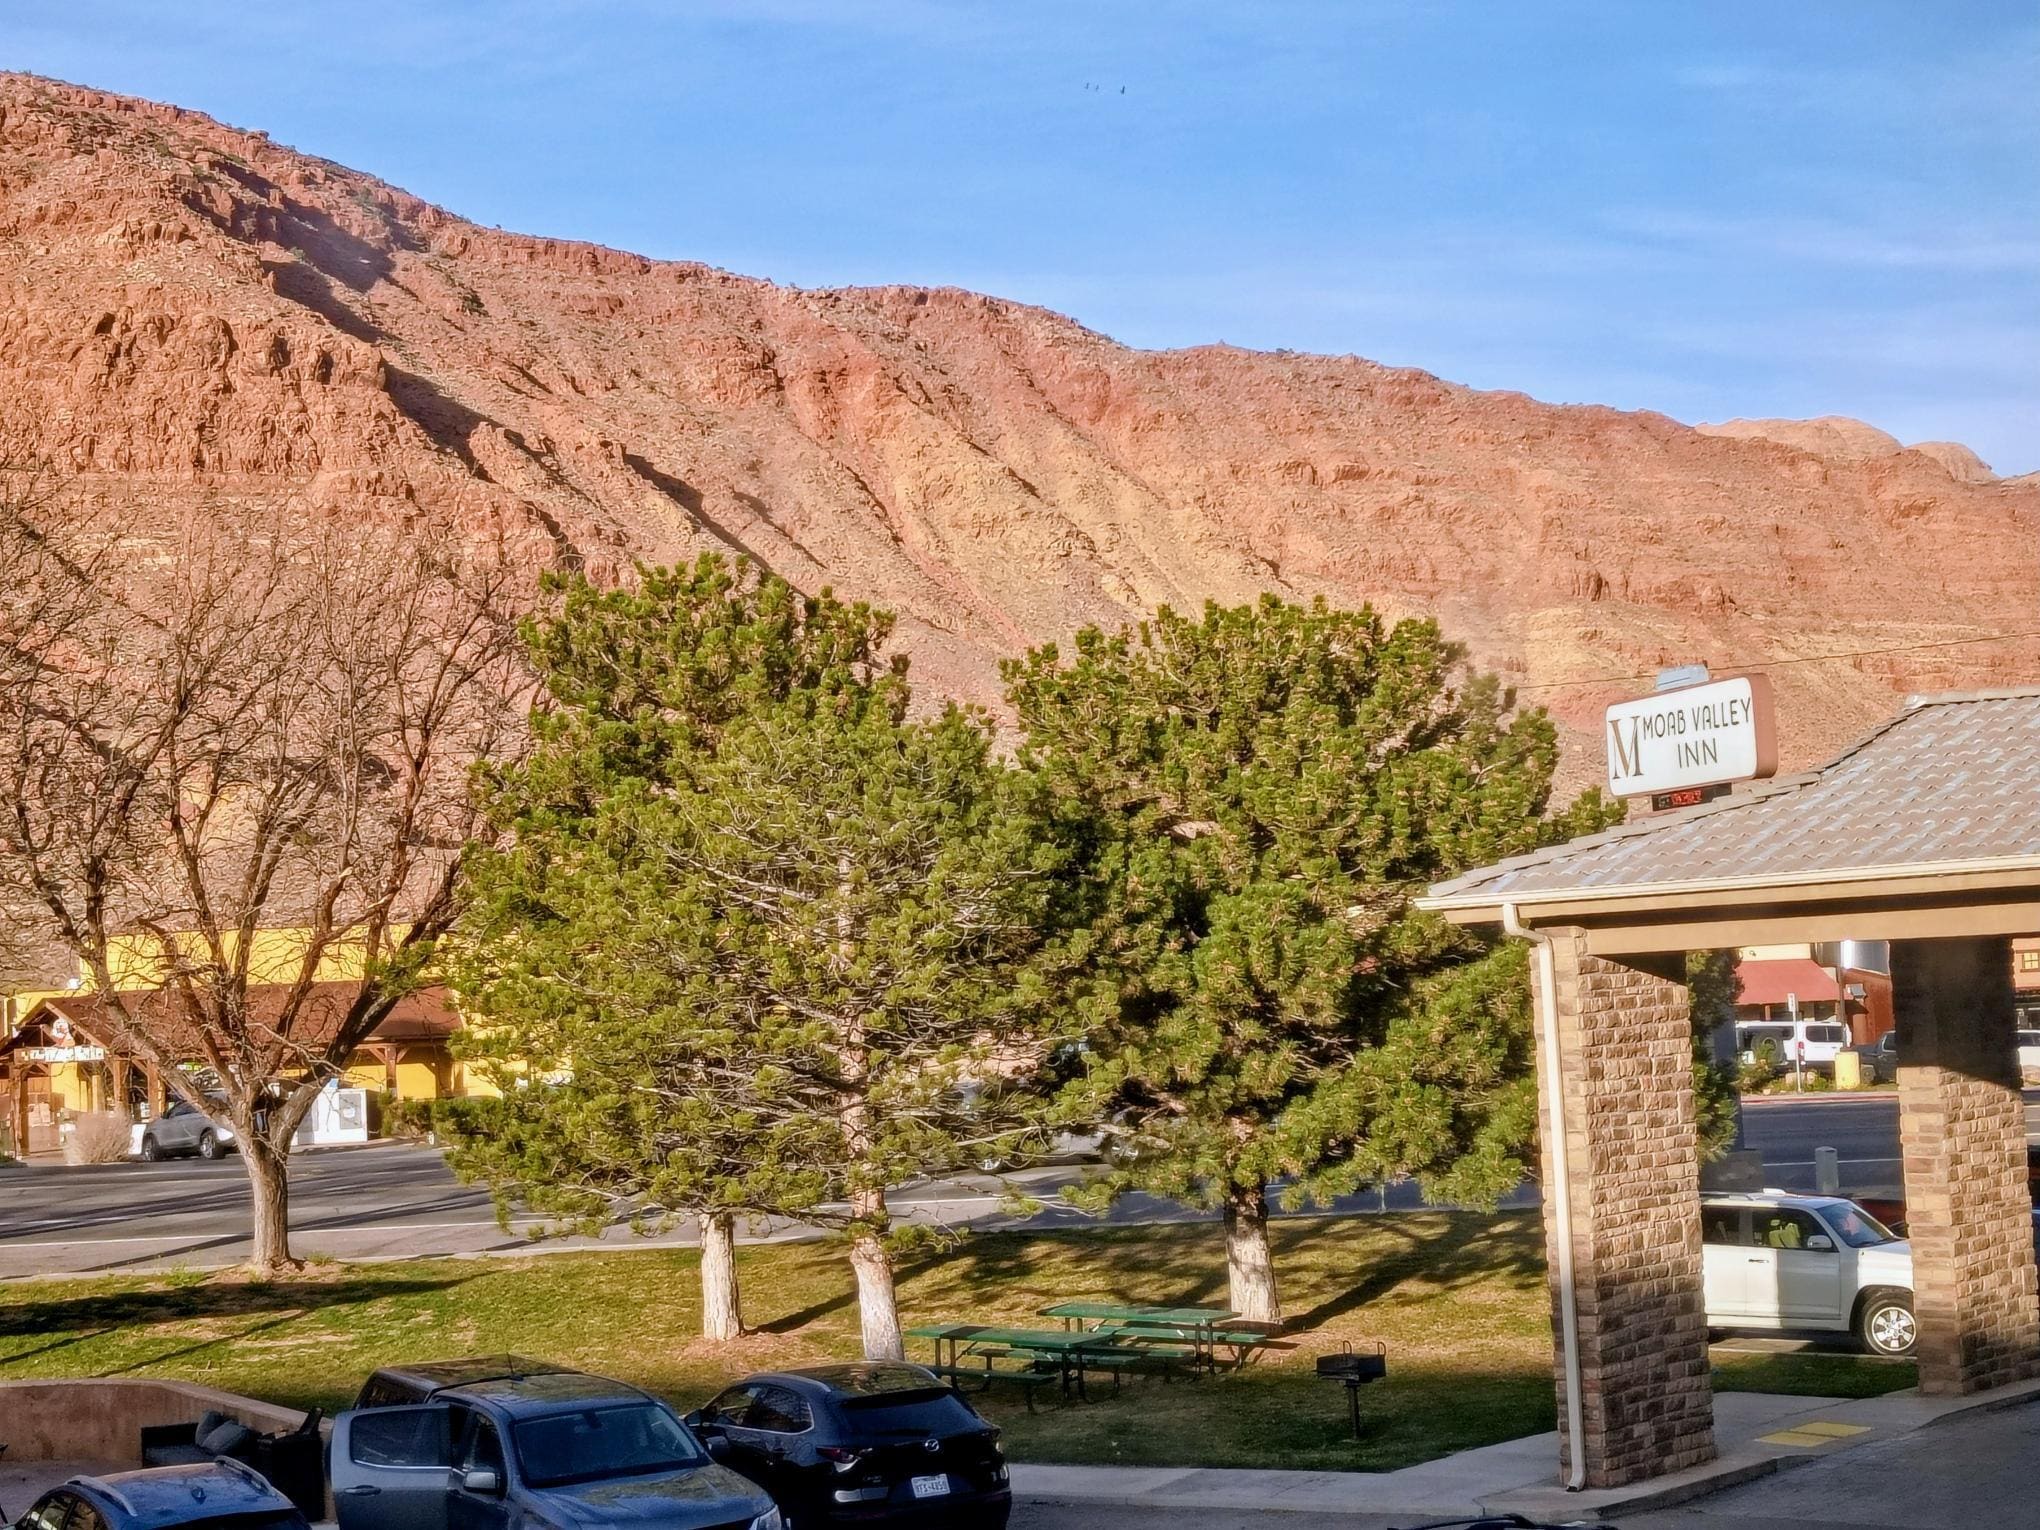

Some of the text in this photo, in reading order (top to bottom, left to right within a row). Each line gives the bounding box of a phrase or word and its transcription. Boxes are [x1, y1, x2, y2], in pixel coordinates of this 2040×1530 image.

[1643, 697, 1751, 740] MOAB VALLEY
[1677, 738, 1718, 769] INN
